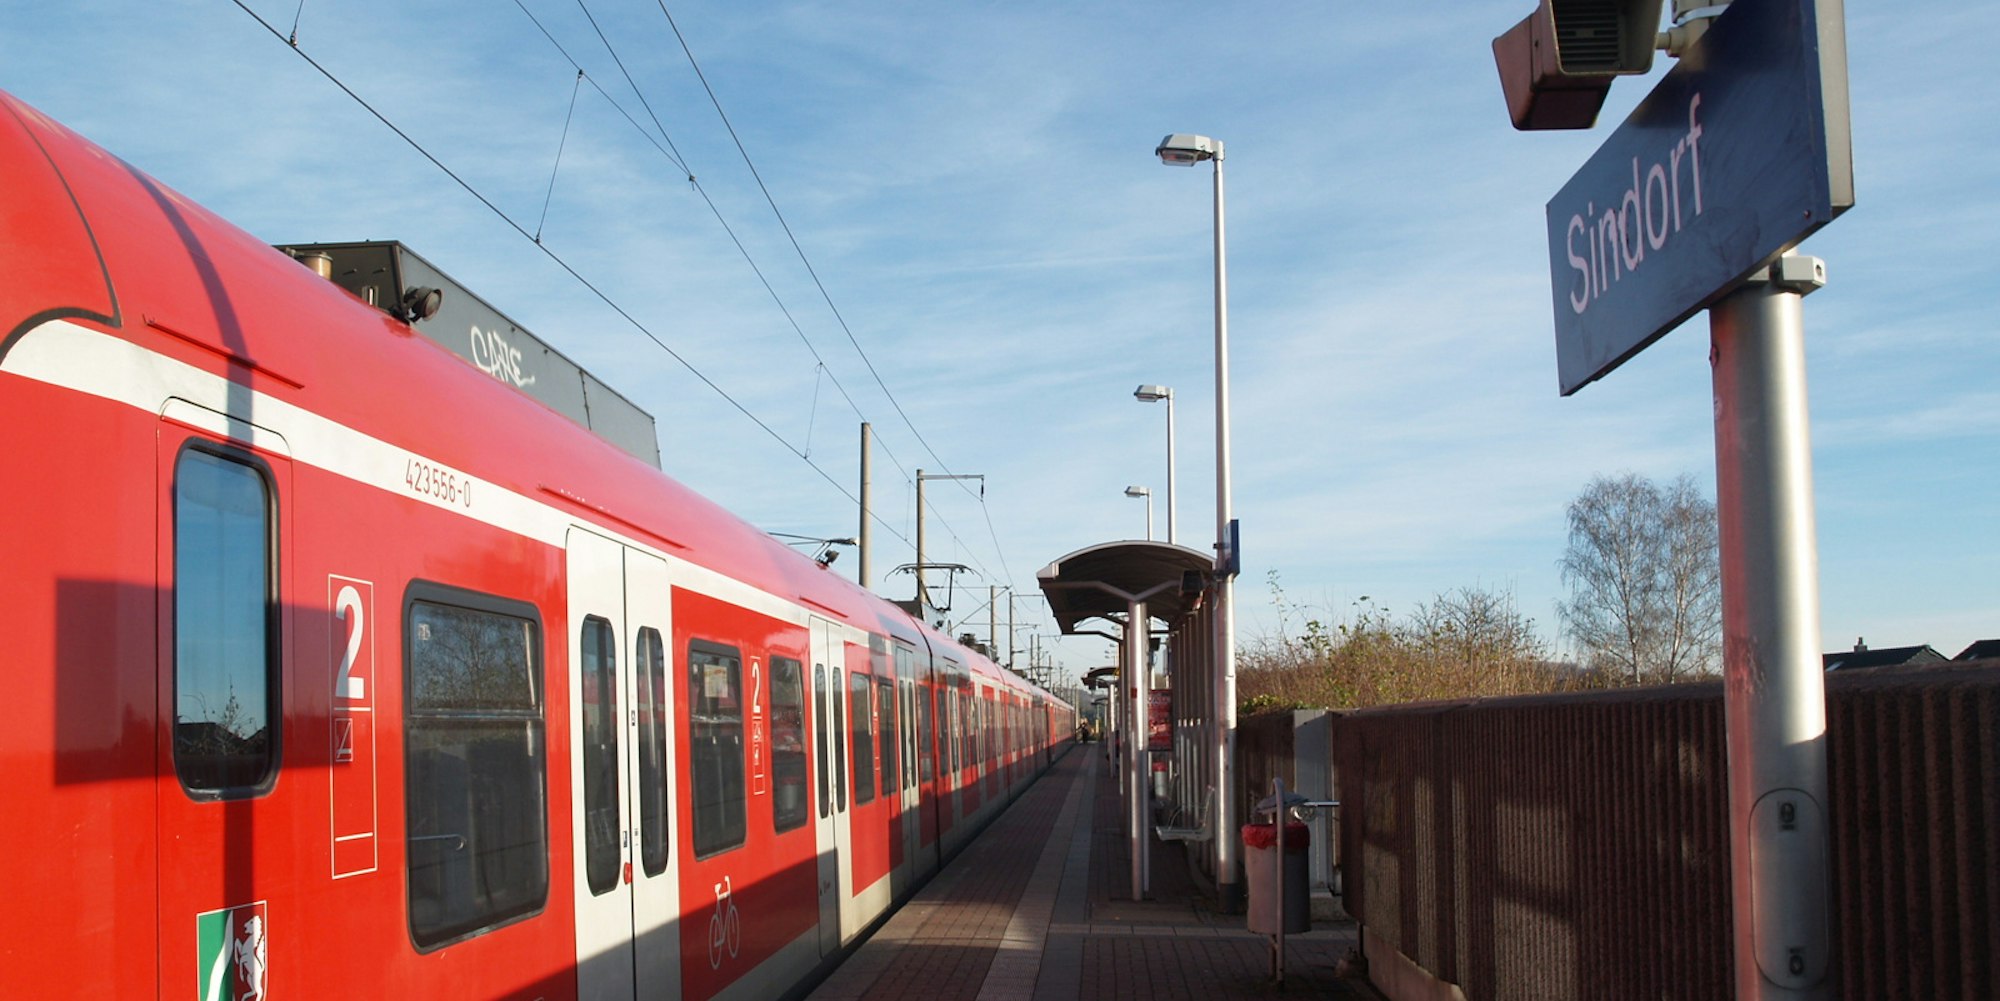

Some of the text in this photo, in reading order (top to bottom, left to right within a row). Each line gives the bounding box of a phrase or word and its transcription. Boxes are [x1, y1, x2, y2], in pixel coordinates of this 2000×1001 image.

[1567, 92, 1702, 314] Sindorf
[406, 459, 471, 507] 423556-0
[336, 586, 364, 699] 2
[752, 662, 761, 713] 2
